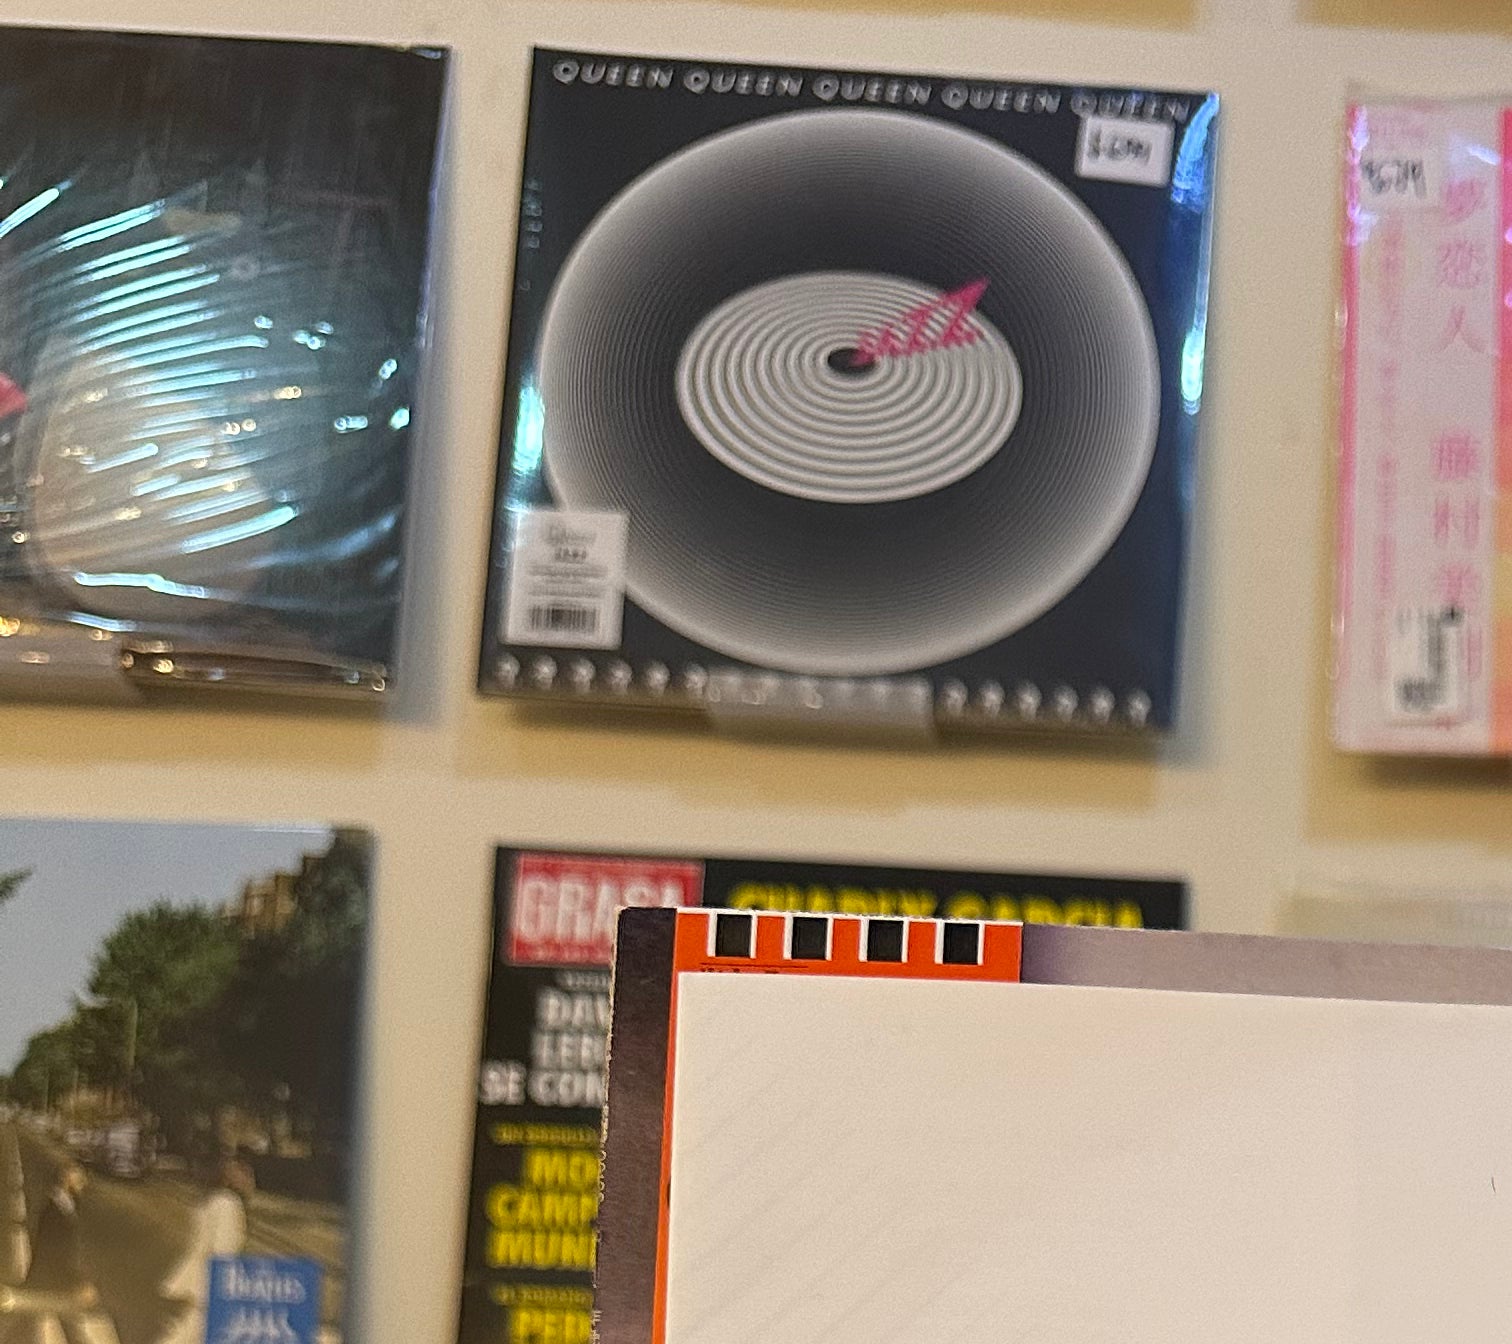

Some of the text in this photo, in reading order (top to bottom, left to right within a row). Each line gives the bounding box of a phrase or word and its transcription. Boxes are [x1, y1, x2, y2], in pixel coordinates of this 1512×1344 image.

[553, 58, 1190, 122] QUEEN QUEEN QUEEN QUEEN QUEEN
